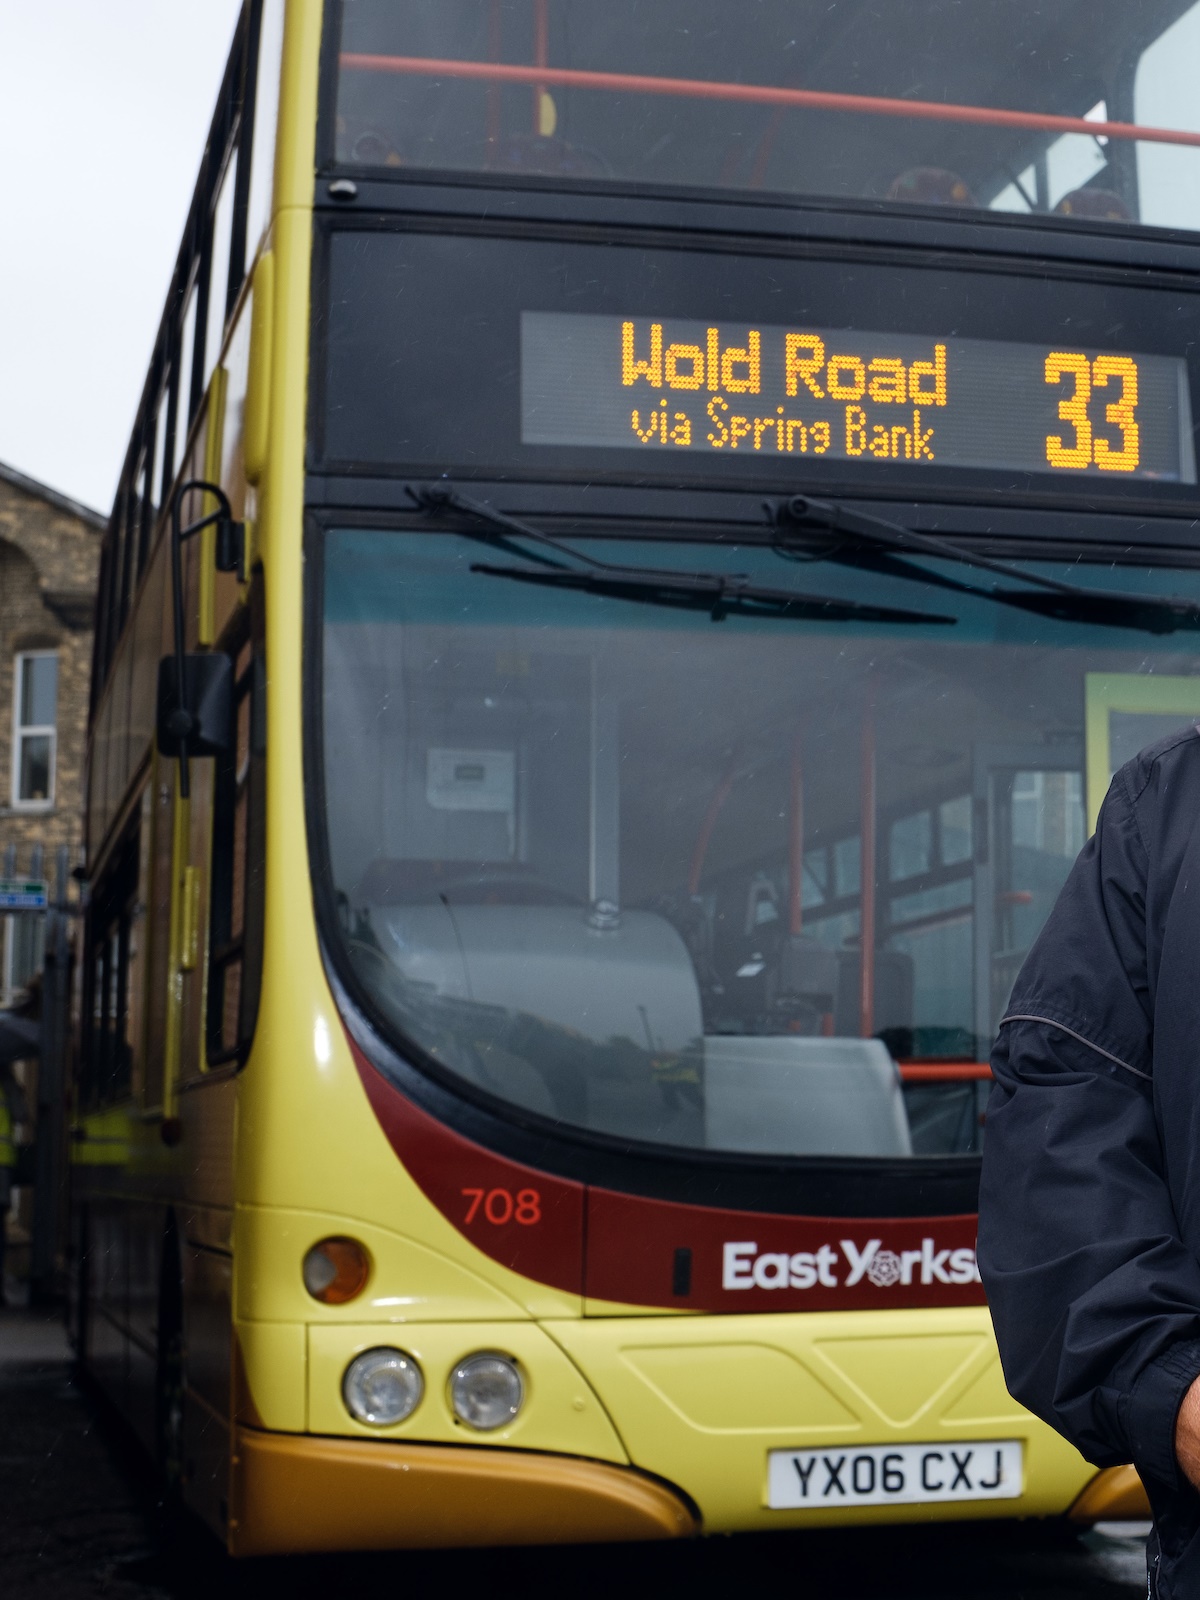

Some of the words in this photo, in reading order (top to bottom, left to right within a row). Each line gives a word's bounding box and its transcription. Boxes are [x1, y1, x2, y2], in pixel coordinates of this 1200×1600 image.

[622, 321, 761, 394] Wold
[785, 333, 947, 406] Road
[631, 399, 691, 445] via
[706, 396, 830, 454] Spring
[845, 405, 935, 461] Bank
[1044, 352, 1140, 471] 33
[461, 1187, 542, 1226] 708
[722, 1241, 838, 1290] East
[839, 1237, 983, 1289] Yorks
[792, 1453, 905, 1498] YX06
[921, 1449, 1003, 1491] CXJ
